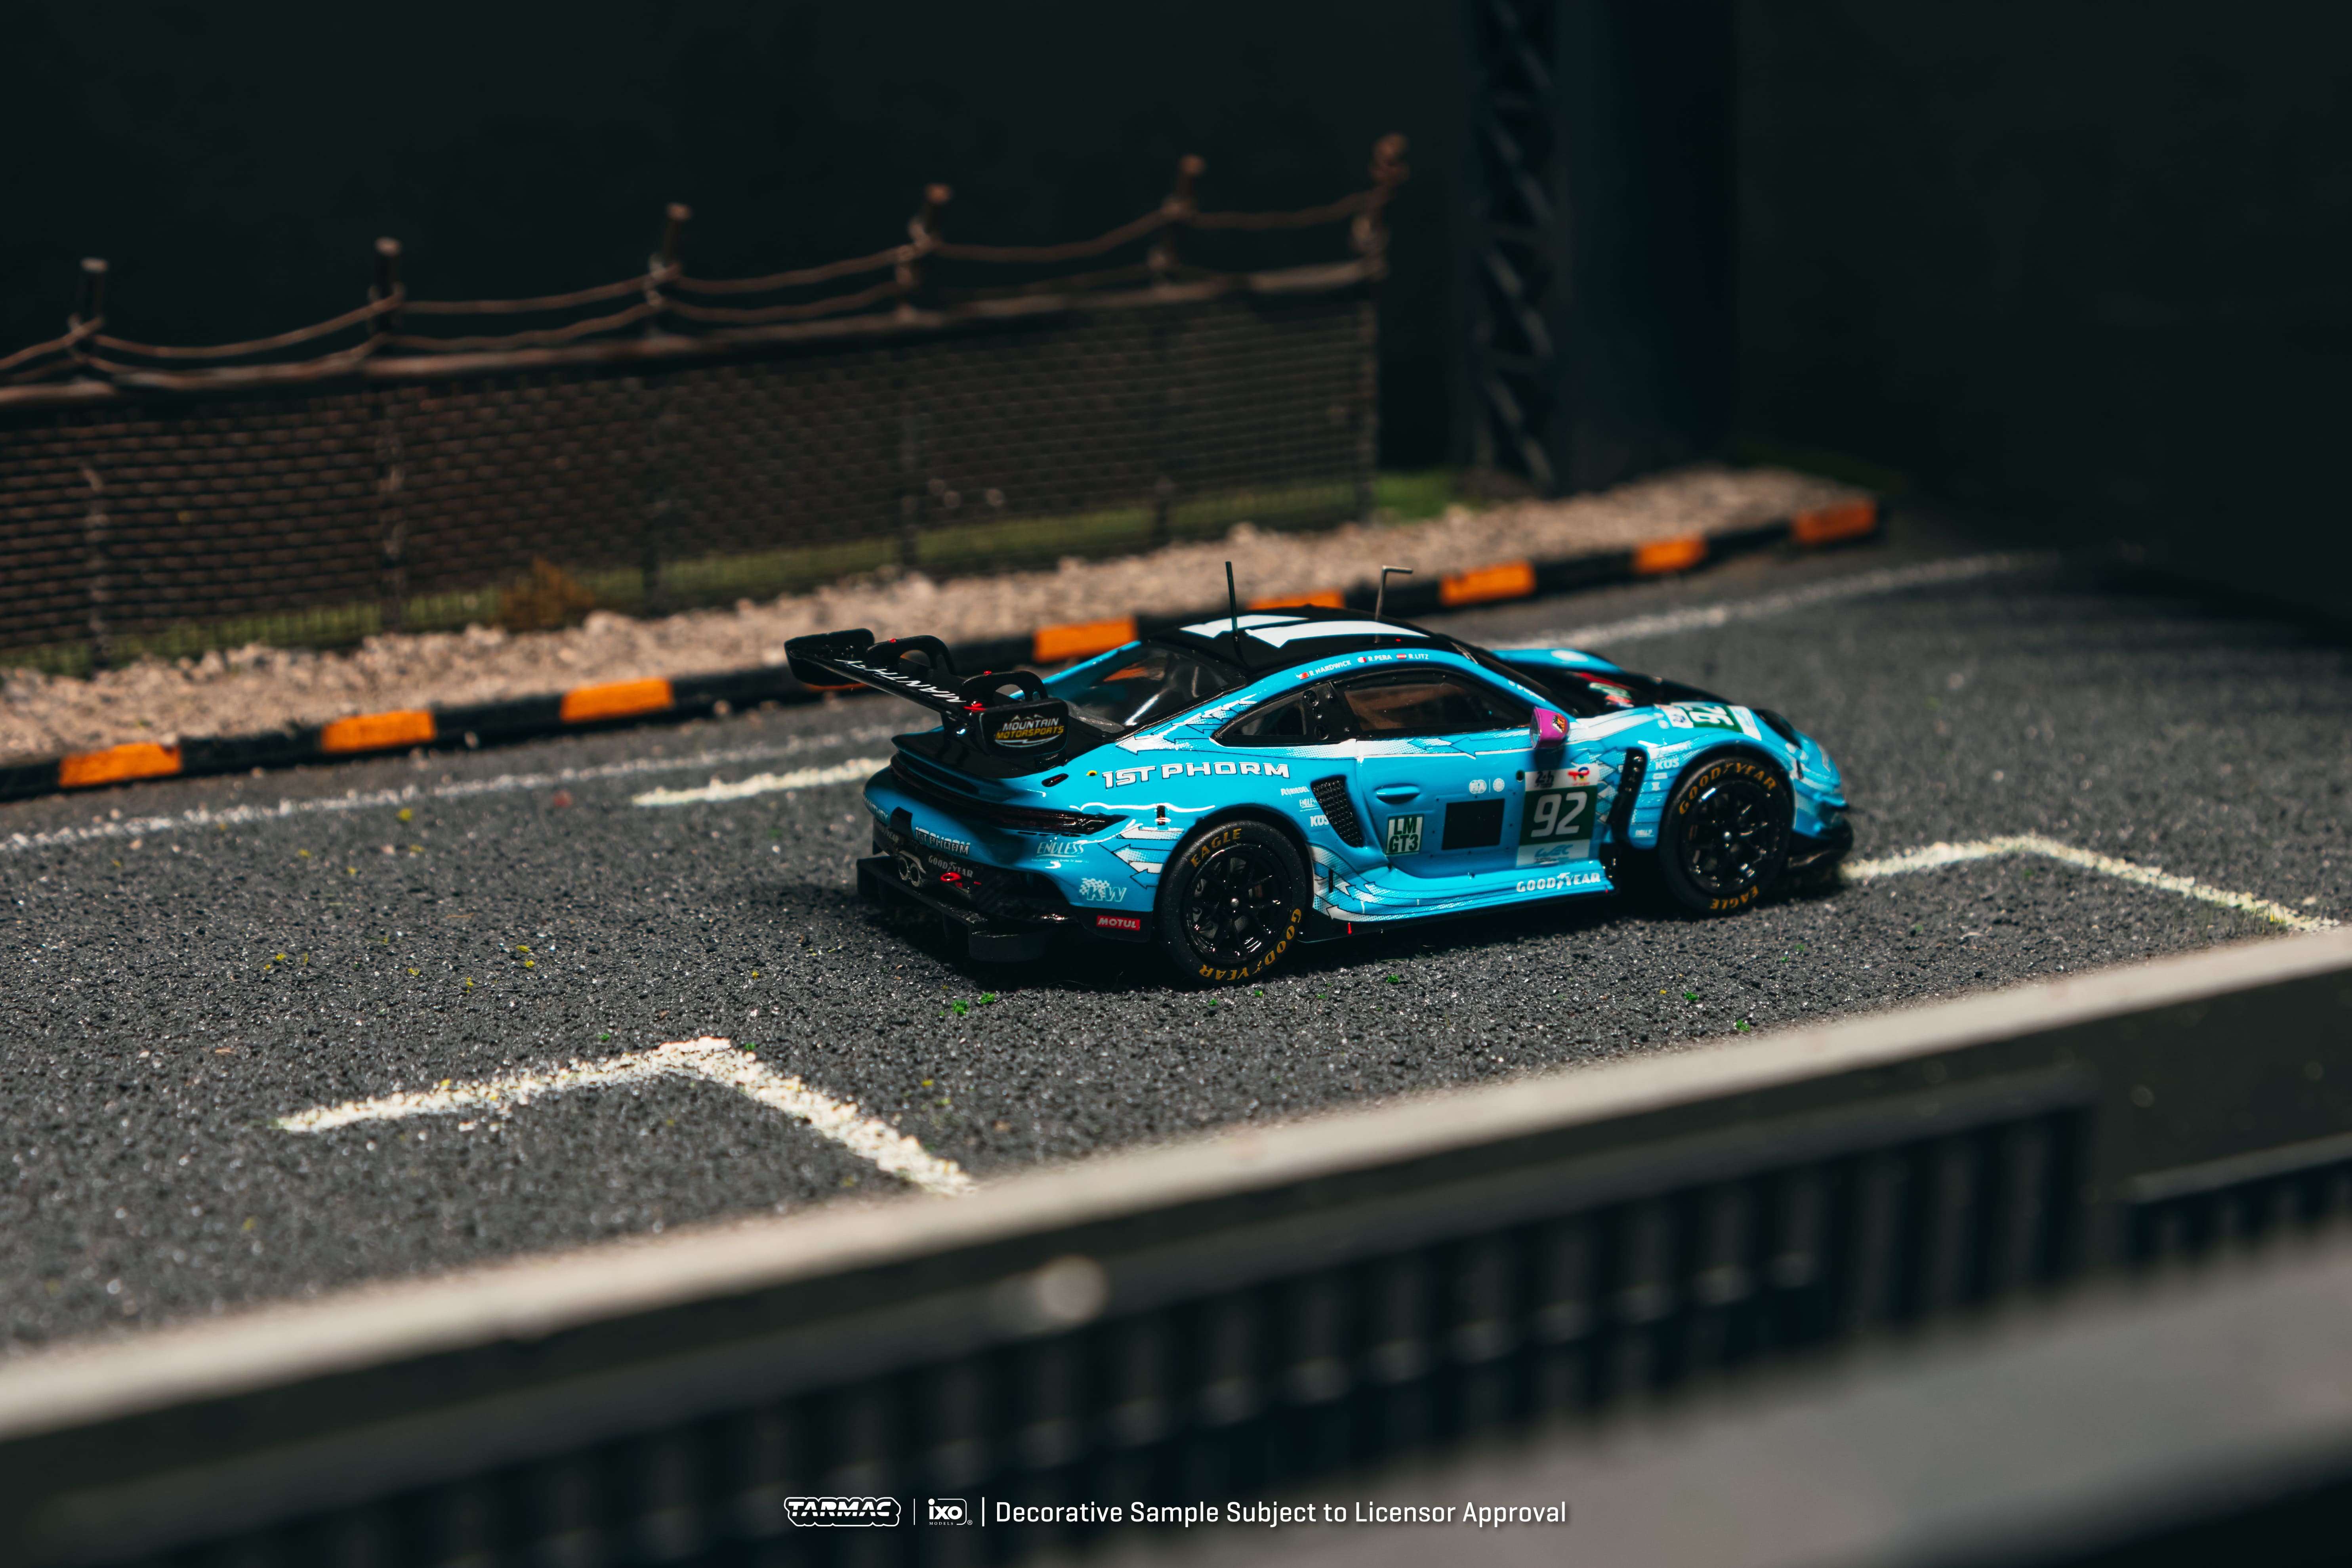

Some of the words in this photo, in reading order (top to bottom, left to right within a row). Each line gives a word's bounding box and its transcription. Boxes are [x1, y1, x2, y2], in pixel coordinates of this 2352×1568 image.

[995, 725, 1064, 739] MOTORSPORTS
[1002, 717, 1059, 731] MOUNTAIN
[1102, 765, 1156, 789] 1ST
[1161, 762, 1290, 779] PHORM
[1531, 792, 1587, 837] 92
[1394, 816, 1417, 835] LM
[1037, 842, 1084, 854] ENDLESS
[1190, 828, 1242, 867] EAGLE
[1389, 834, 1418, 853] GT3
[1087, 886, 1127, 902] KW
[1709, 885, 1759, 910] EAGLE
[1098, 918, 1136, 928] MOTUL
